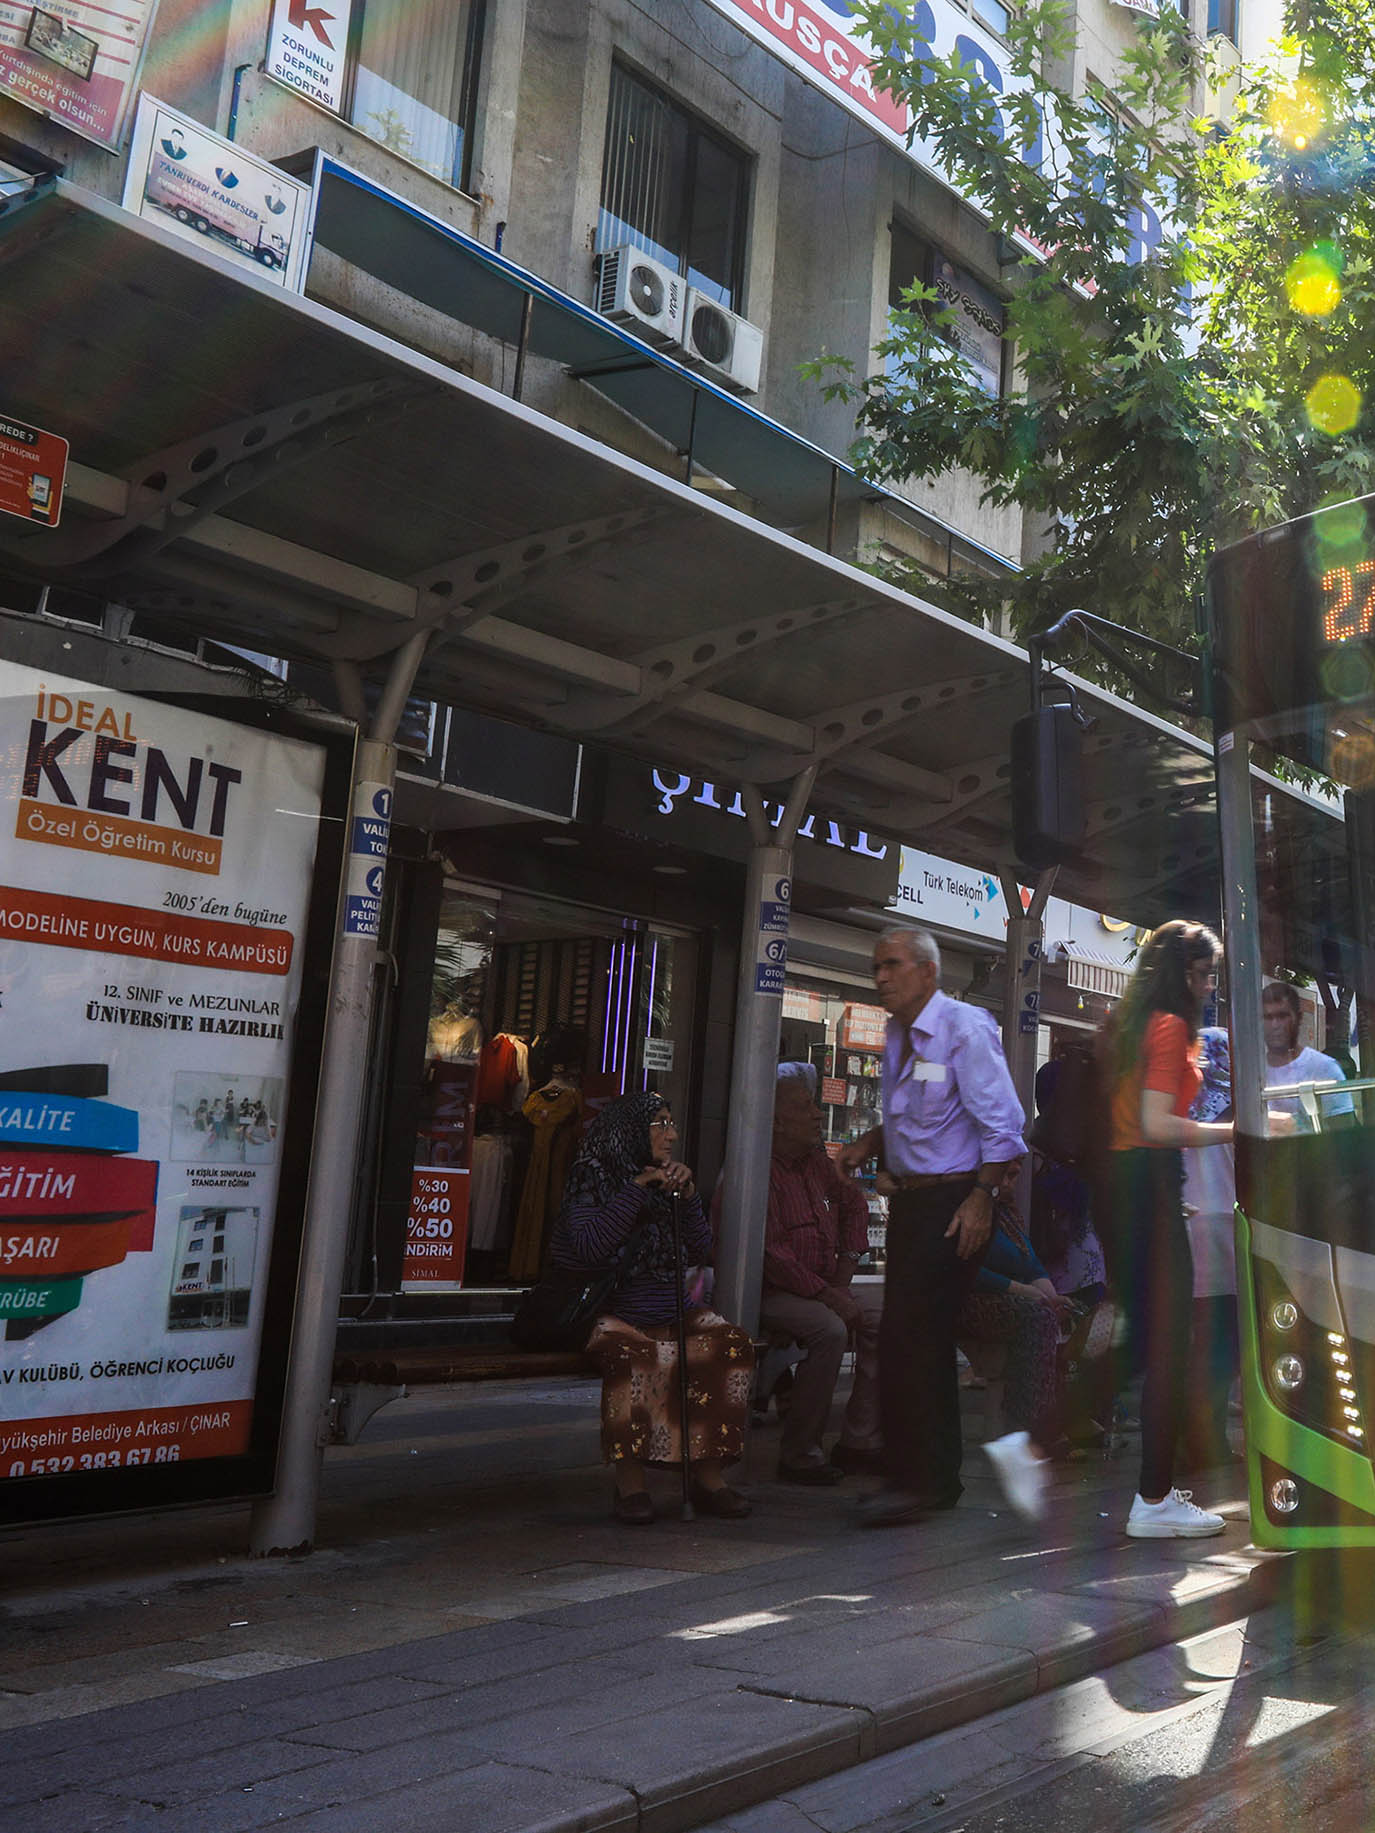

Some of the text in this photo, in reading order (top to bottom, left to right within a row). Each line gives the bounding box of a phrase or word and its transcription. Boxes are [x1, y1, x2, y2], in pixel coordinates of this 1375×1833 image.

[282, 33, 334, 73] ZORUNLU
[754, 0, 877, 103] USÇA
[275, 64, 334, 105] SİGORTASI
[283, 51, 329, 87] DEPREM
[8, 70, 56, 105] gerçek
[37, 683, 137, 741] İDEAL
[22, 719, 242, 837] KENT
[28, 809, 216, 865] Özel Öğretim Kursu
[923, 870, 983, 901] Türk Telekom
[163, 891, 288, 926] 2005'den bugüne
[94, 922, 158, 950] UYGUN,
[163, 934, 201, 955] KURS
[206, 940, 288, 967] KAMPÜSÜ
[86, 1001, 194, 1032] ÜNİVERSİTE
[103, 984, 280, 1016] 12. SINIF ve MEZUNLAR
[191, 1178, 227, 1187] STANDART
[418, 1178, 449, 1193] %30
[412, 1197, 451, 1214] %40
[406, 1217, 454, 1239] %50
[0, 1287, 53, 1309] RÜBE
[19, 1362, 85, 1383] KULÜBÜ,
[90, 1357, 163, 1378] ÖĞRENCİ
[167, 1353, 235, 1375] KOÇLUĞU
[71, 1423, 132, 1445] Belediye
[135, 1419, 180, 1437] Arkası
[190, 1411, 231, 1436] ÇINAR
